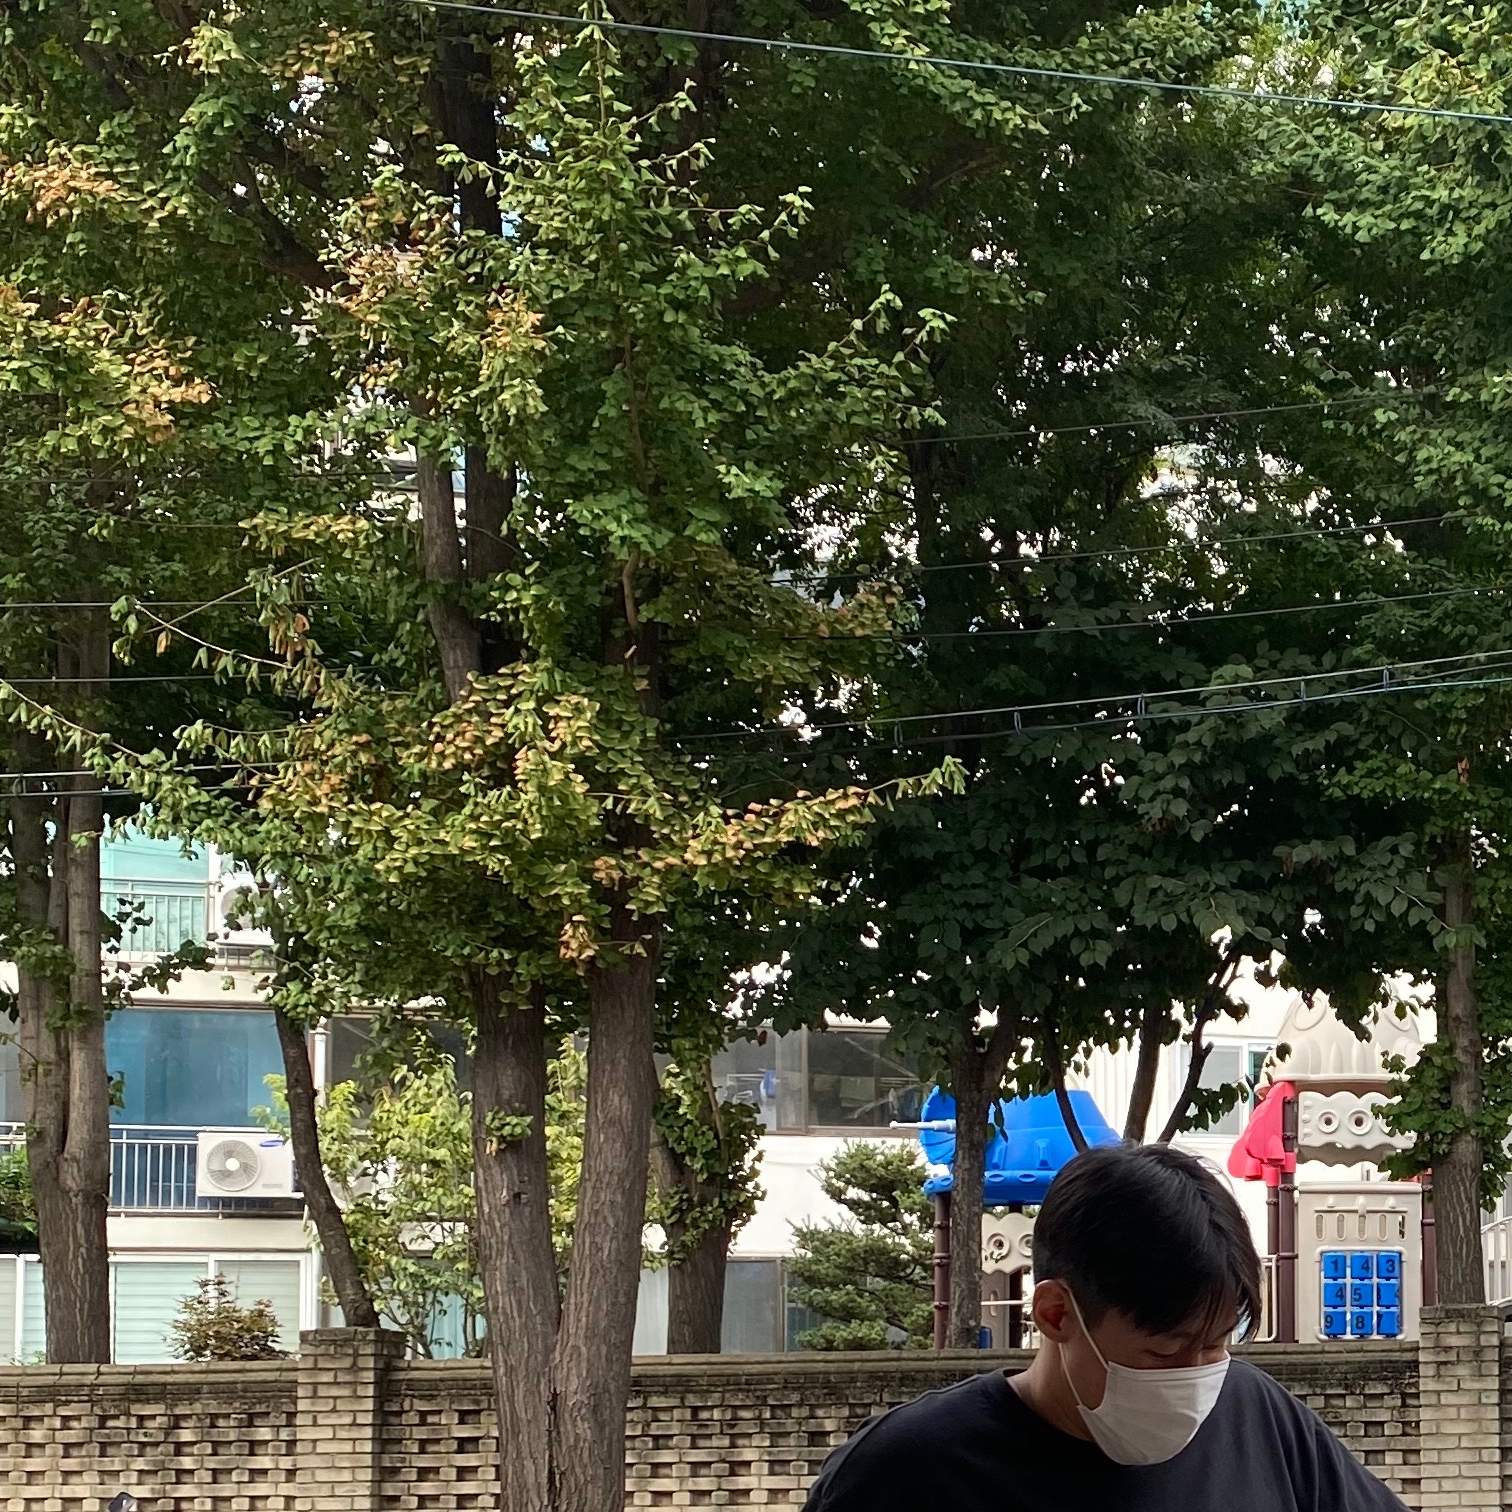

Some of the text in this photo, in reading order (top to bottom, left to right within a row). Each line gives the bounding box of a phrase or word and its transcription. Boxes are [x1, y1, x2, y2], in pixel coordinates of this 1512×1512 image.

[1330, 1258, 1396, 1273] 1 4 3
[1335, 1286, 1344, 1301] 4
[1352, 1287, 1363, 1302] 5
[1325, 1314, 1334, 1329] 9
[1355, 1315, 1365, 1330] 8
